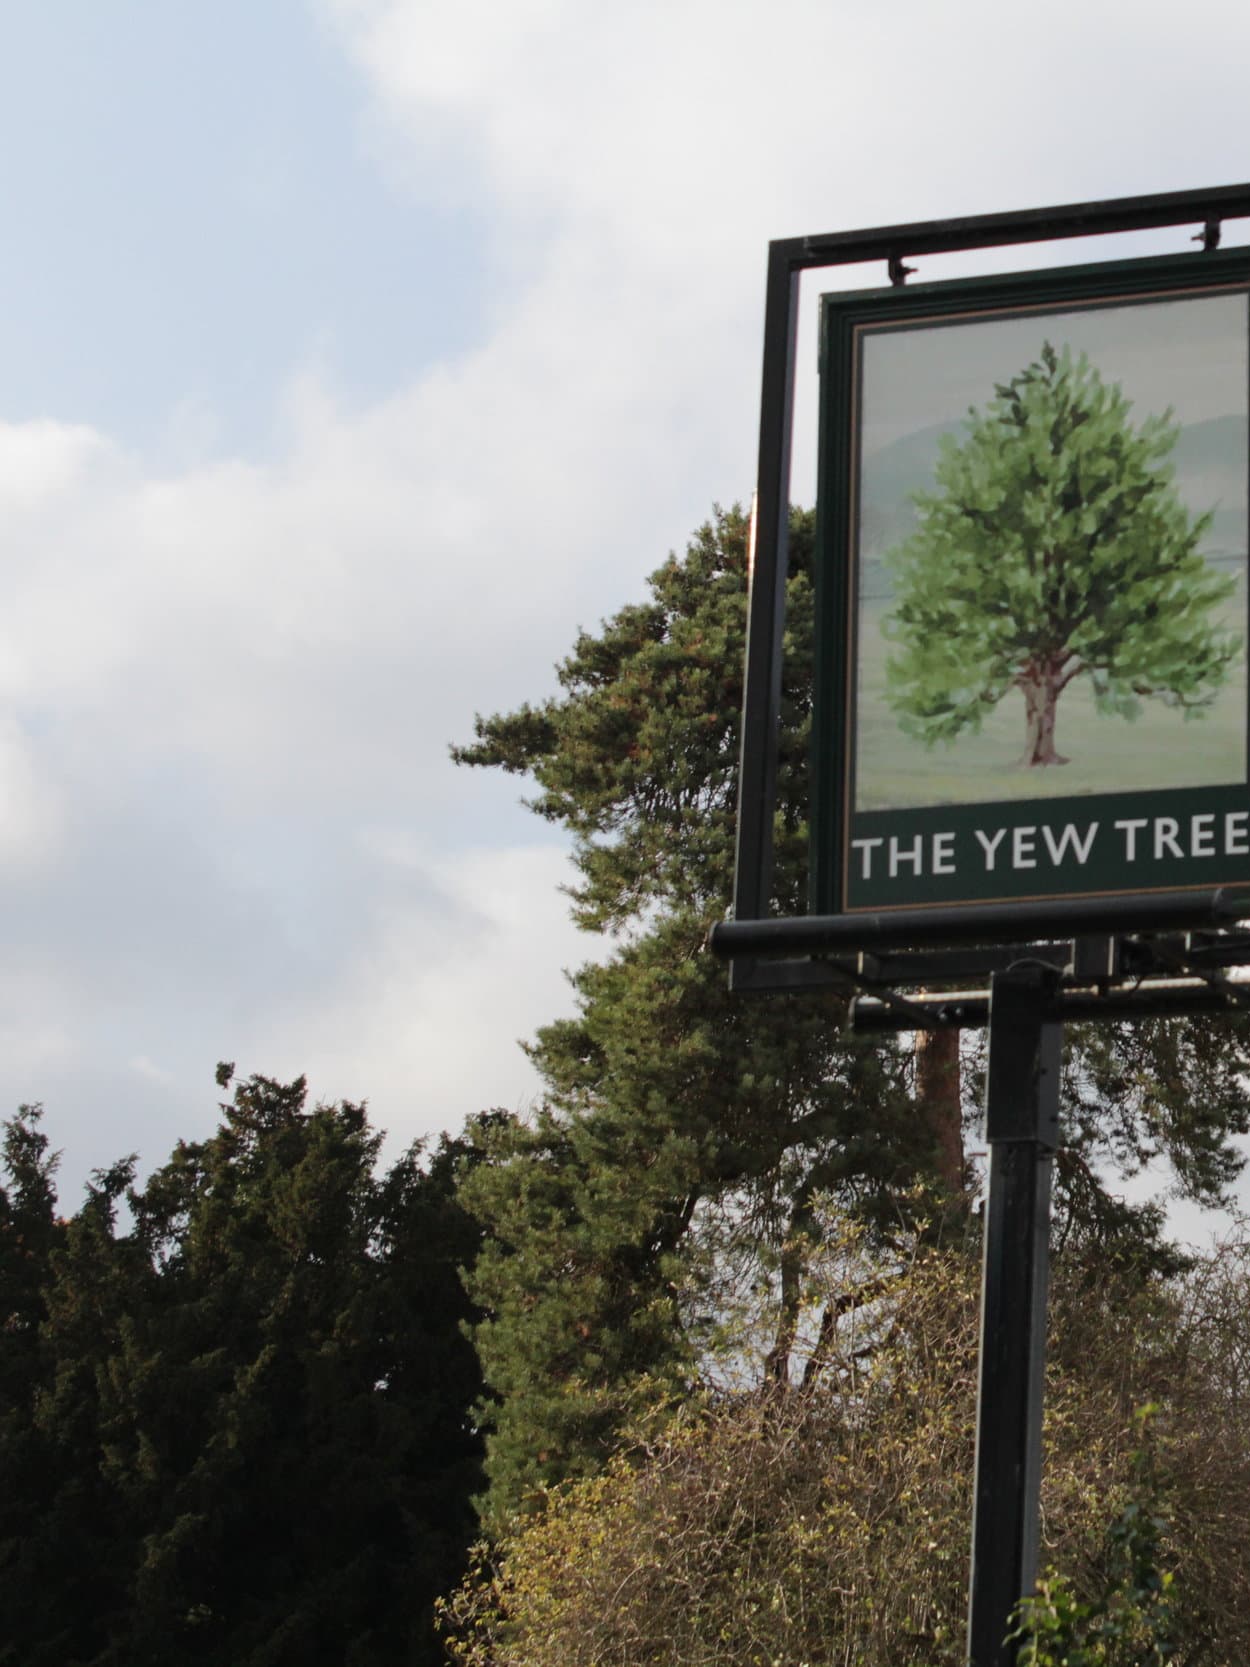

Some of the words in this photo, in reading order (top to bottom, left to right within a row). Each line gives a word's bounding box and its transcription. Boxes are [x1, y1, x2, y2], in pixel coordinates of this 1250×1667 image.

[851, 832, 956, 880] THE
[974, 822, 1099, 871] YEW
[1114, 811, 1250, 862] TREE
